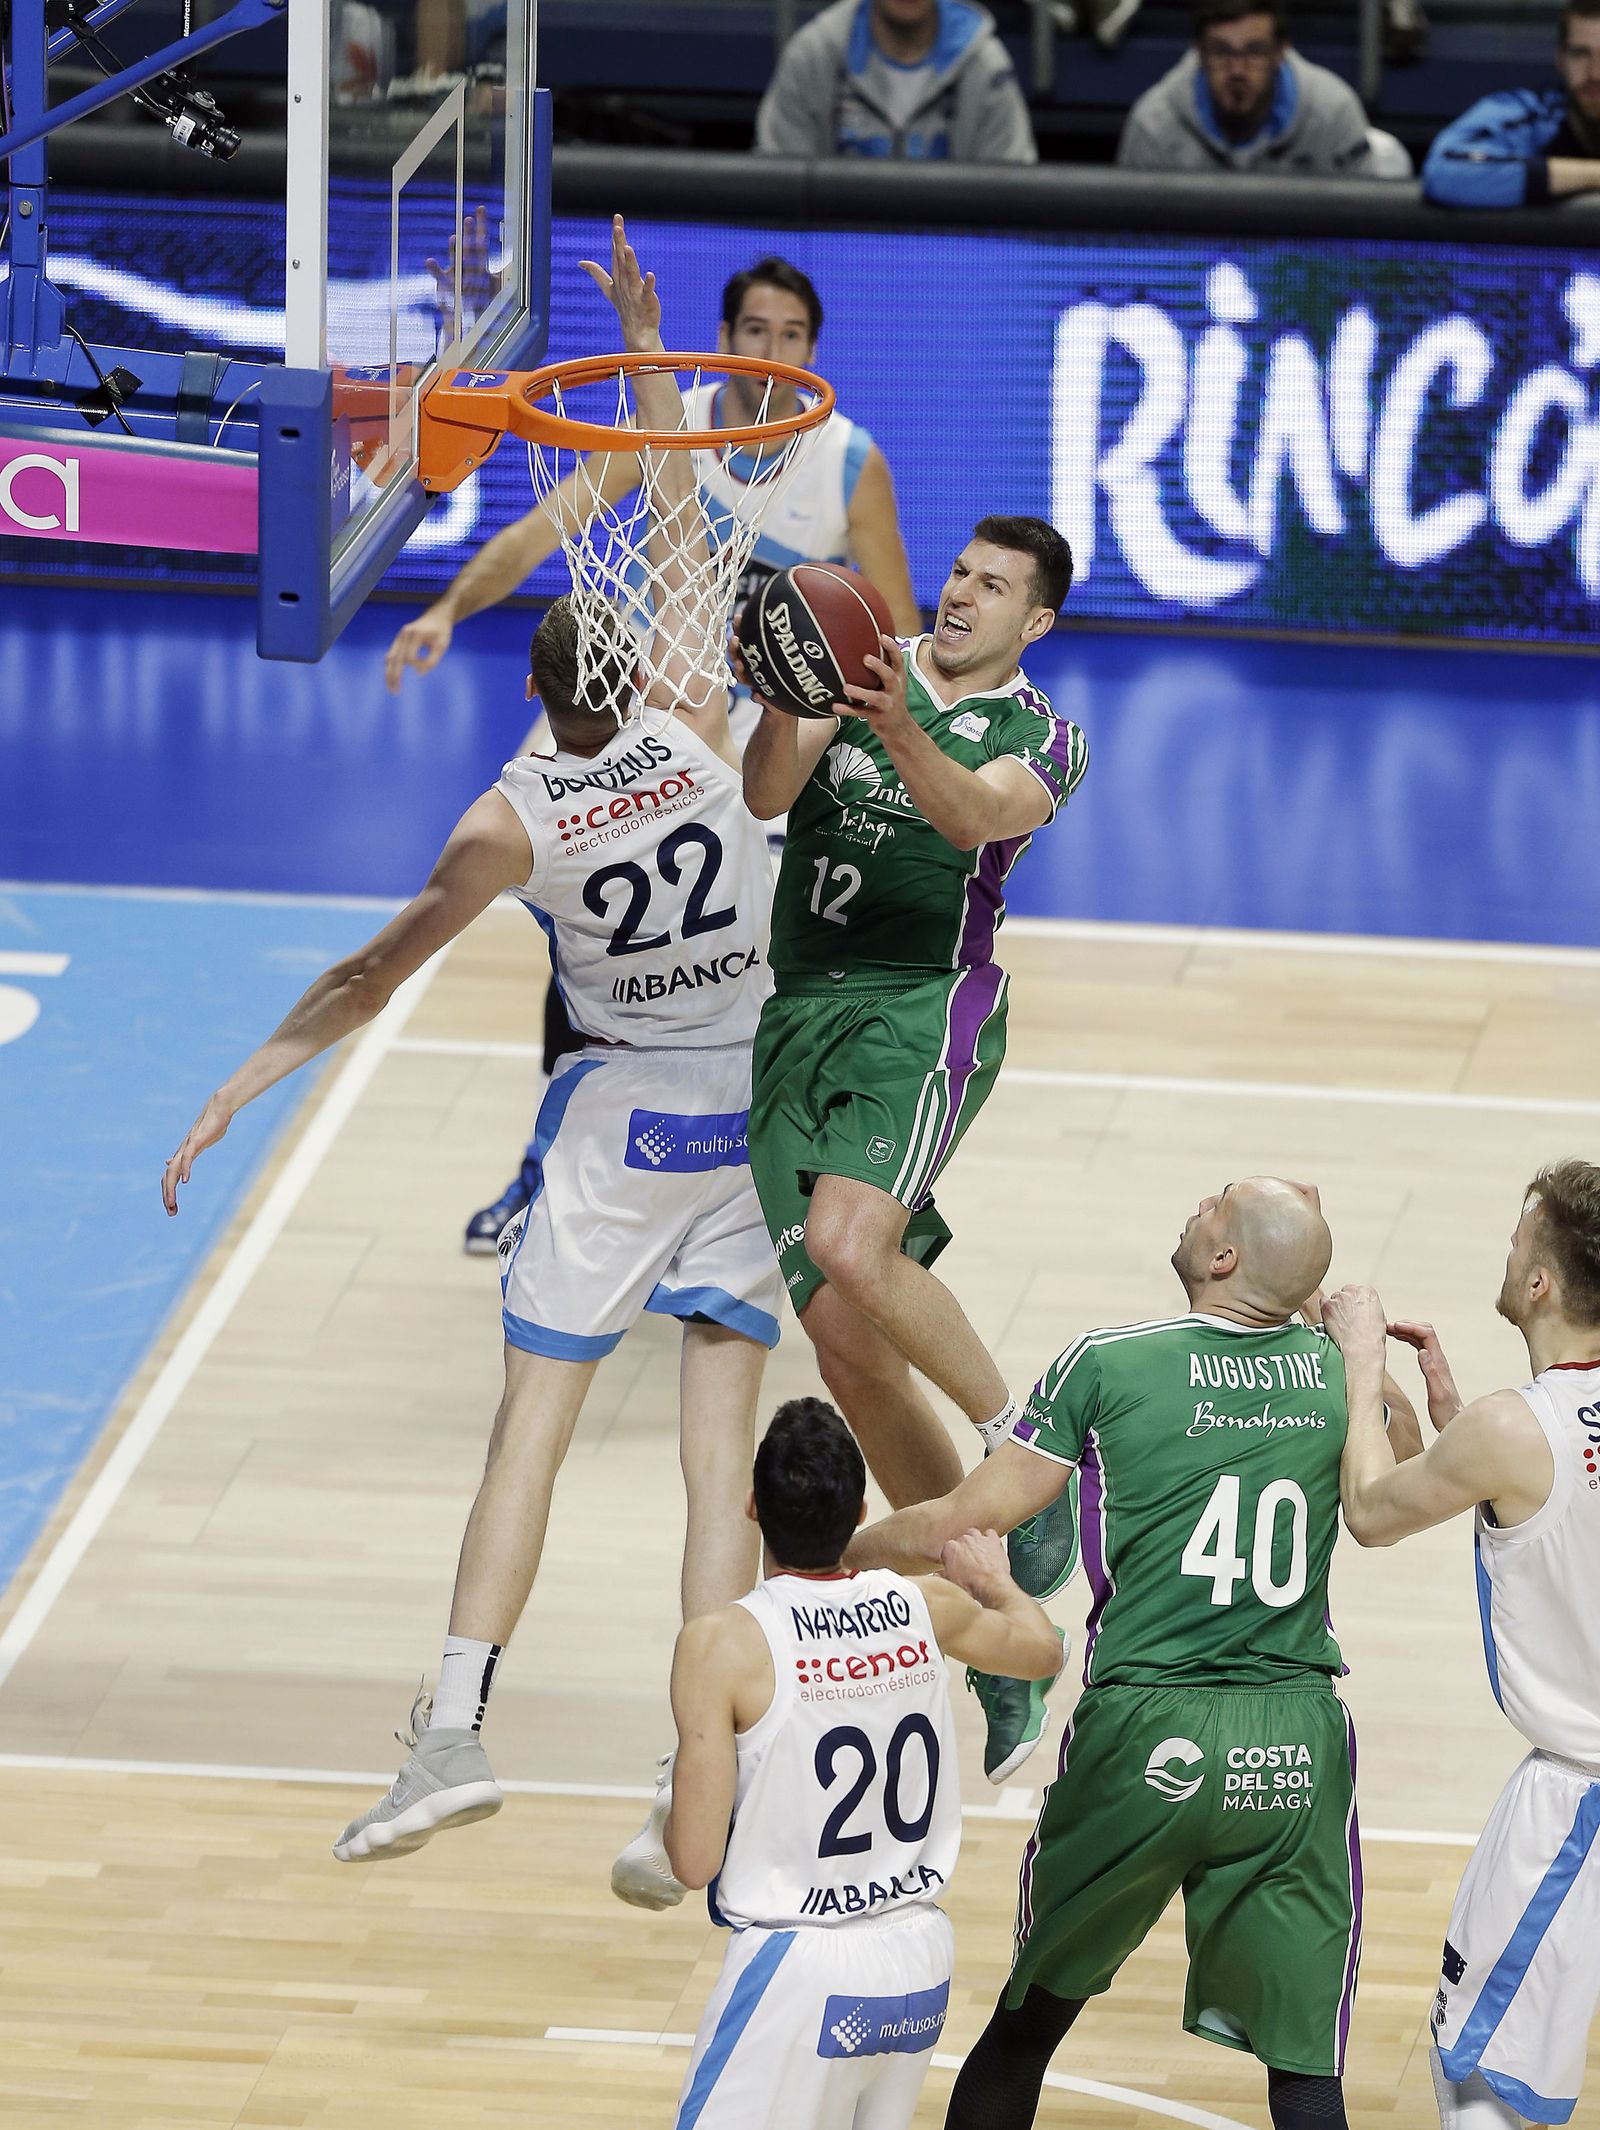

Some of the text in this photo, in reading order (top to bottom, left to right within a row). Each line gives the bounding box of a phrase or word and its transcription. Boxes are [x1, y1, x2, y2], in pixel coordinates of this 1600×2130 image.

[765, 601, 834, 705] SPALDING
[586, 767, 695, 829] cenor
[582, 822, 737, 957] 22
[810, 855, 862, 926] 12
[1189, 1353, 1327, 1390] AUGUSTINE
[1181, 1474, 1310, 1608] 40
[814, 1713, 940, 1859] 20
[1224, 1770, 1314, 1791] DEL SOL
[1226, 1743, 1313, 1769] COSTA
[1222, 1790, 1312, 1811] MÁLAGA
